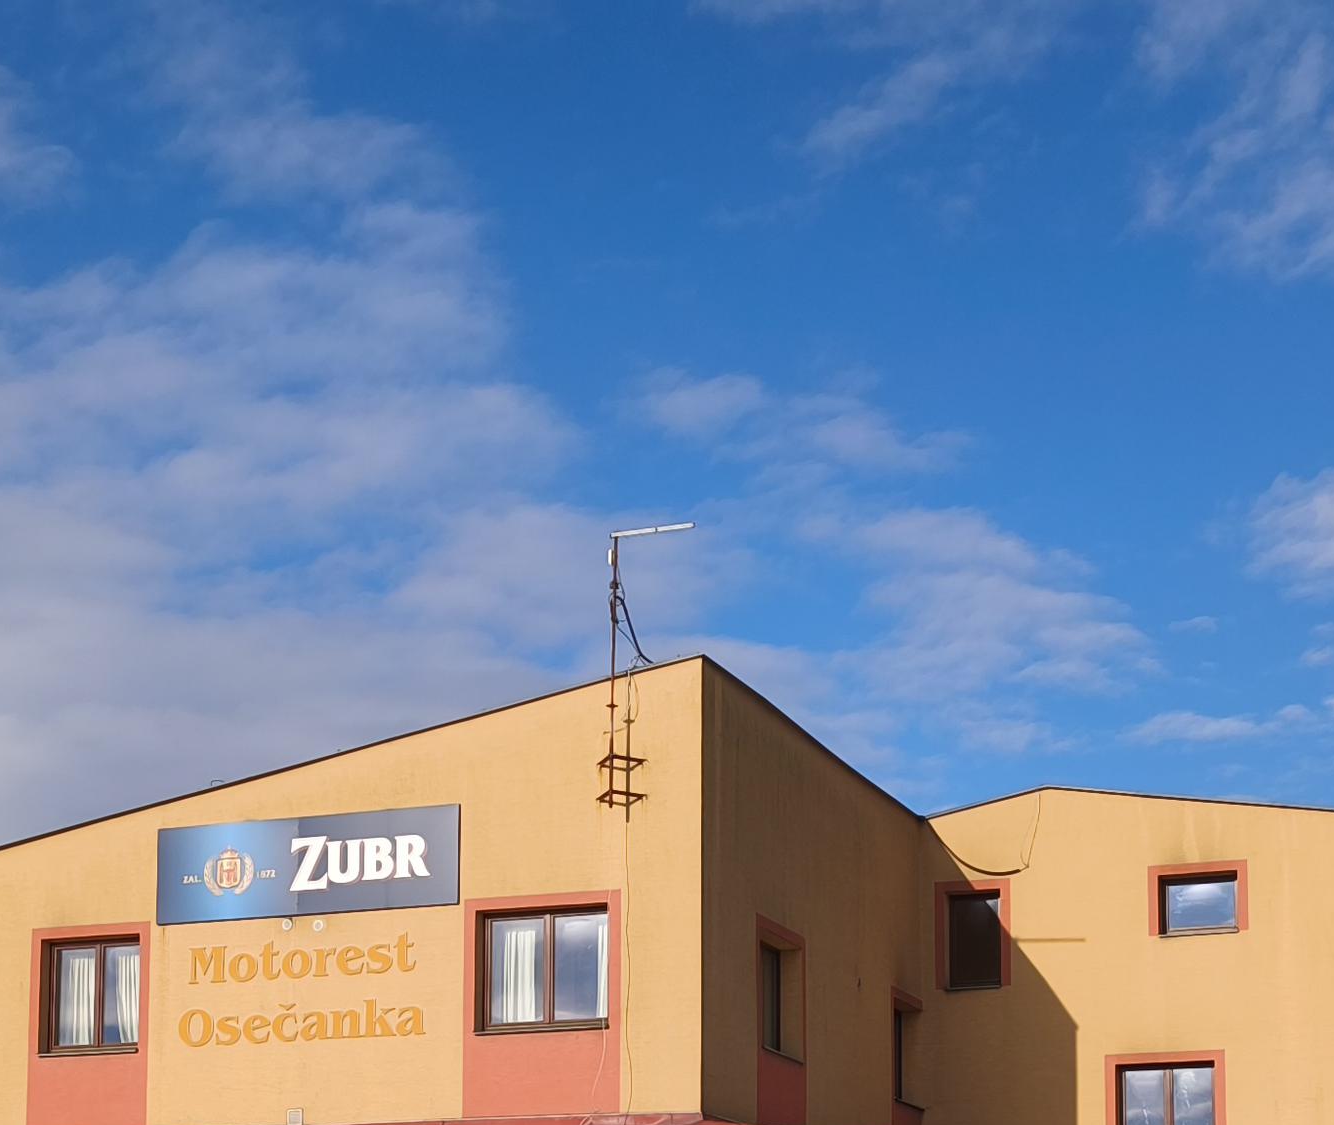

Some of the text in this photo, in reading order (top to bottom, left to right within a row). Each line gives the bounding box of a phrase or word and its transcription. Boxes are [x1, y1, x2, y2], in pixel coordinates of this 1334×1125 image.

[289, 834, 431, 891] ZUBR
[188, 931, 417, 985] Motorest
[178, 998, 426, 1047] Osečanka
